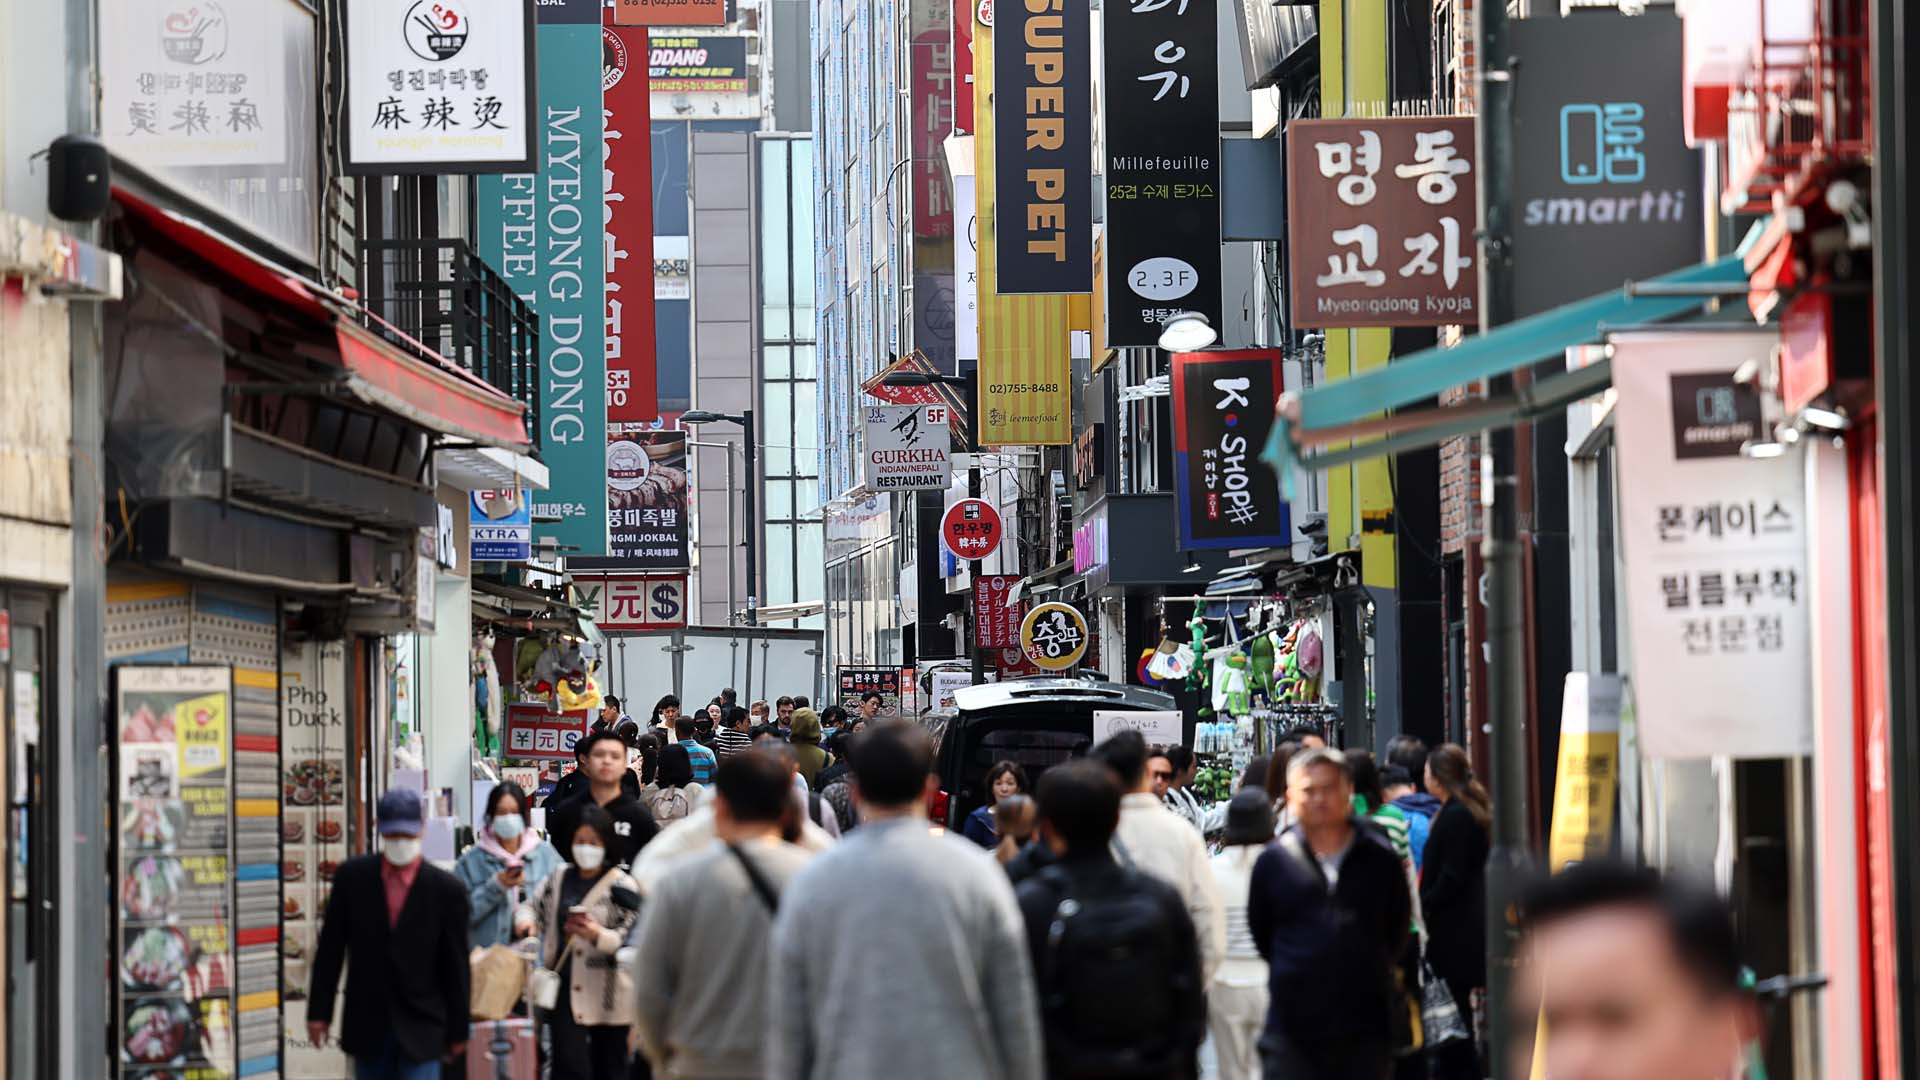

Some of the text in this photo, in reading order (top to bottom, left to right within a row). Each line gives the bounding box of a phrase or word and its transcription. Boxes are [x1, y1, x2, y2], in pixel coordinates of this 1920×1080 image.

[649, 48, 709, 66] DDANG
[387, 68, 488, 91] 영진마라탕
[371, 96, 510, 131] 麻辣烫
[1113, 157, 1209, 170] Millefeuille
[1315, 130, 1470, 205] 명동
[1110, 184, 1214, 199] 25겹 수제 돈가스
[1027, 168, 1066, 261] PET
[1524, 191, 1686, 227] smartti
[502, 174, 536, 278] FFEE
[1316, 217, 1472, 290] 교자
[547, 106, 585, 446] MYEONG DONG
[1317, 294, 1472, 314] Myeongdong Kyoja
[989, 383, 1059, 395] 02)755-8488
[1213, 377, 1250, 410] K
[927, 409, 945, 423] 5F
[871, 449, 946, 465] GURKHA
[879, 464, 939, 474] INDIAN/NEPALI
[876, 475, 943, 488] RESTAURANT
[474, 529, 519, 539] KTRA
[611, 533, 679, 543] NGMI JOKBAL
[611, 586, 642, 619] 元
[651, 583, 680, 620] $
[287, 686, 328, 705] Pho
[287, 707, 342, 728] Duck
[538, 732, 555, 748] 元
